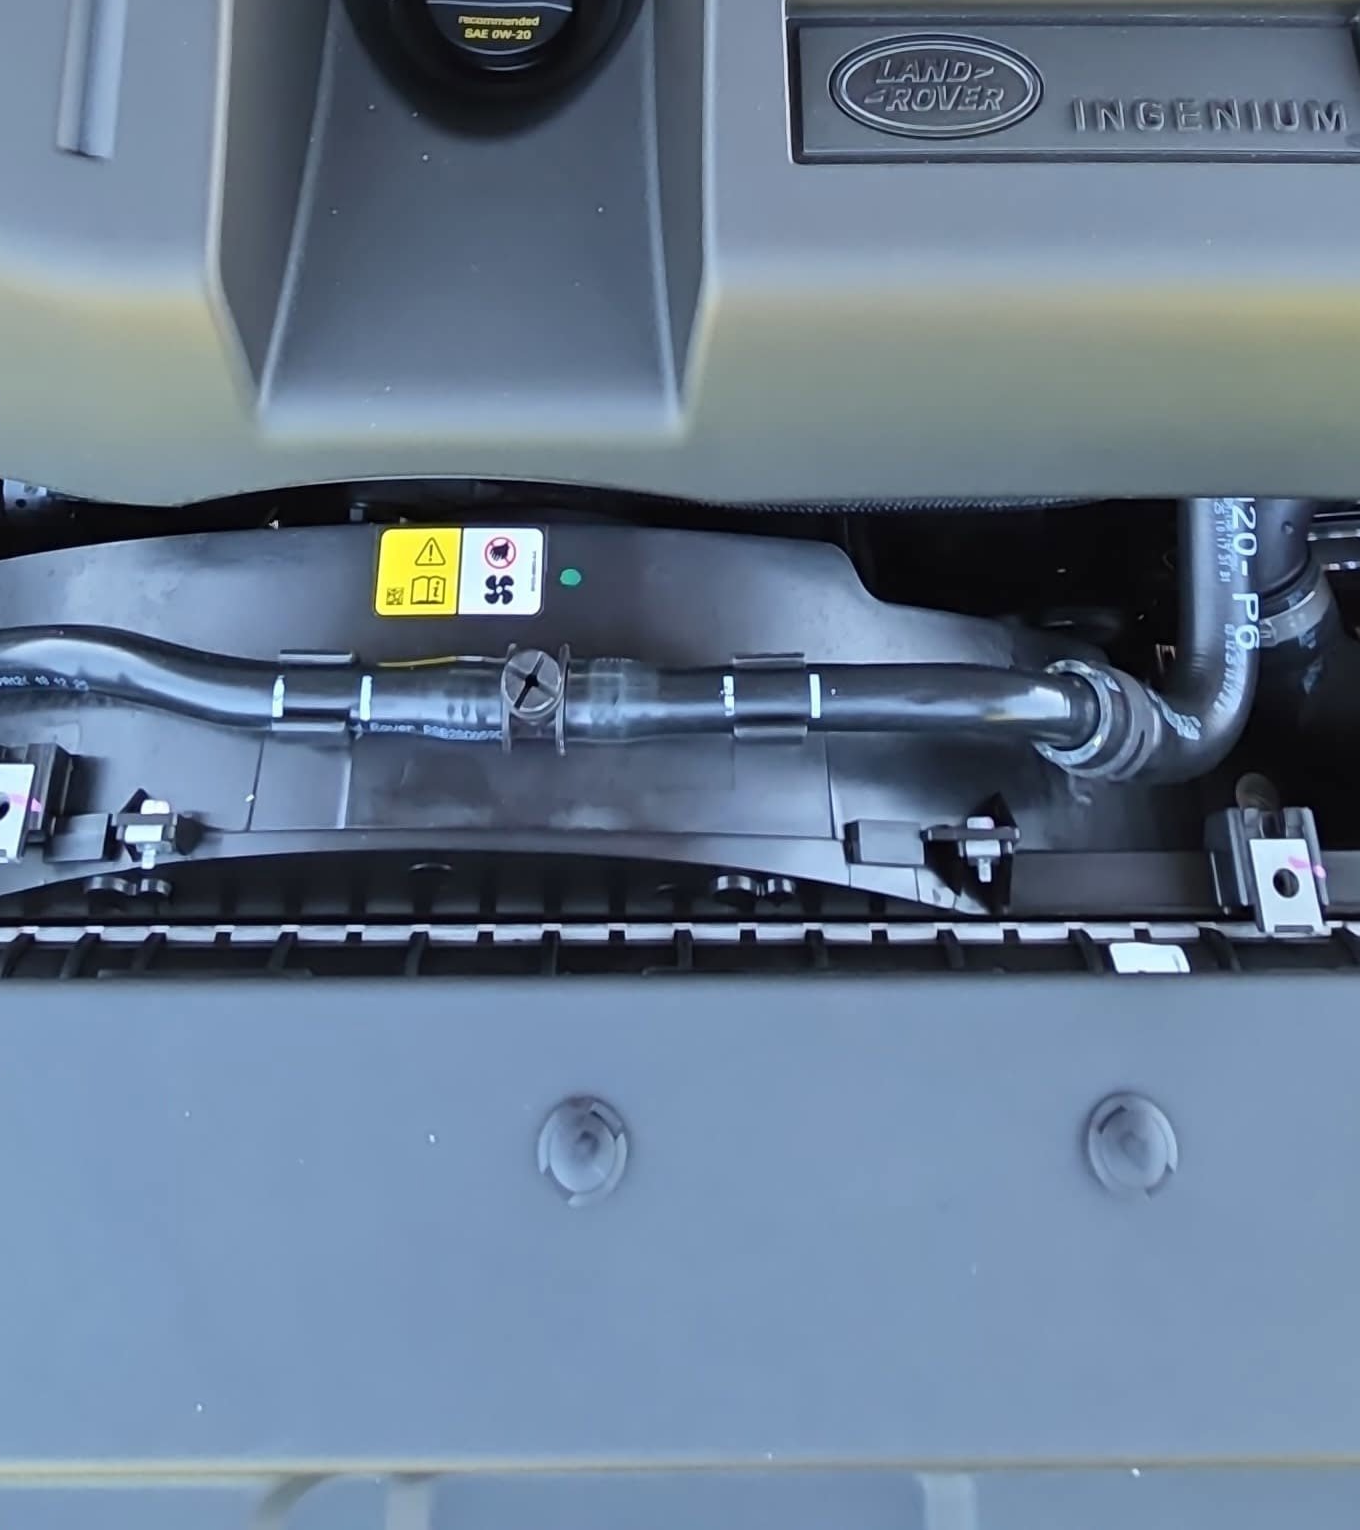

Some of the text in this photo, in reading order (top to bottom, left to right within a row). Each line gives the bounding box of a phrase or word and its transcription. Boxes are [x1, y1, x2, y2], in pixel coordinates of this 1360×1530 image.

[464, 28, 532, 41] SAE 0W-20
[875, 57, 975, 83] LAND
[886, 85, 1005, 112] ROVER
[1069, 97, 1348, 134] INGENIUM
[1232, 592, 1260, 651] P6
